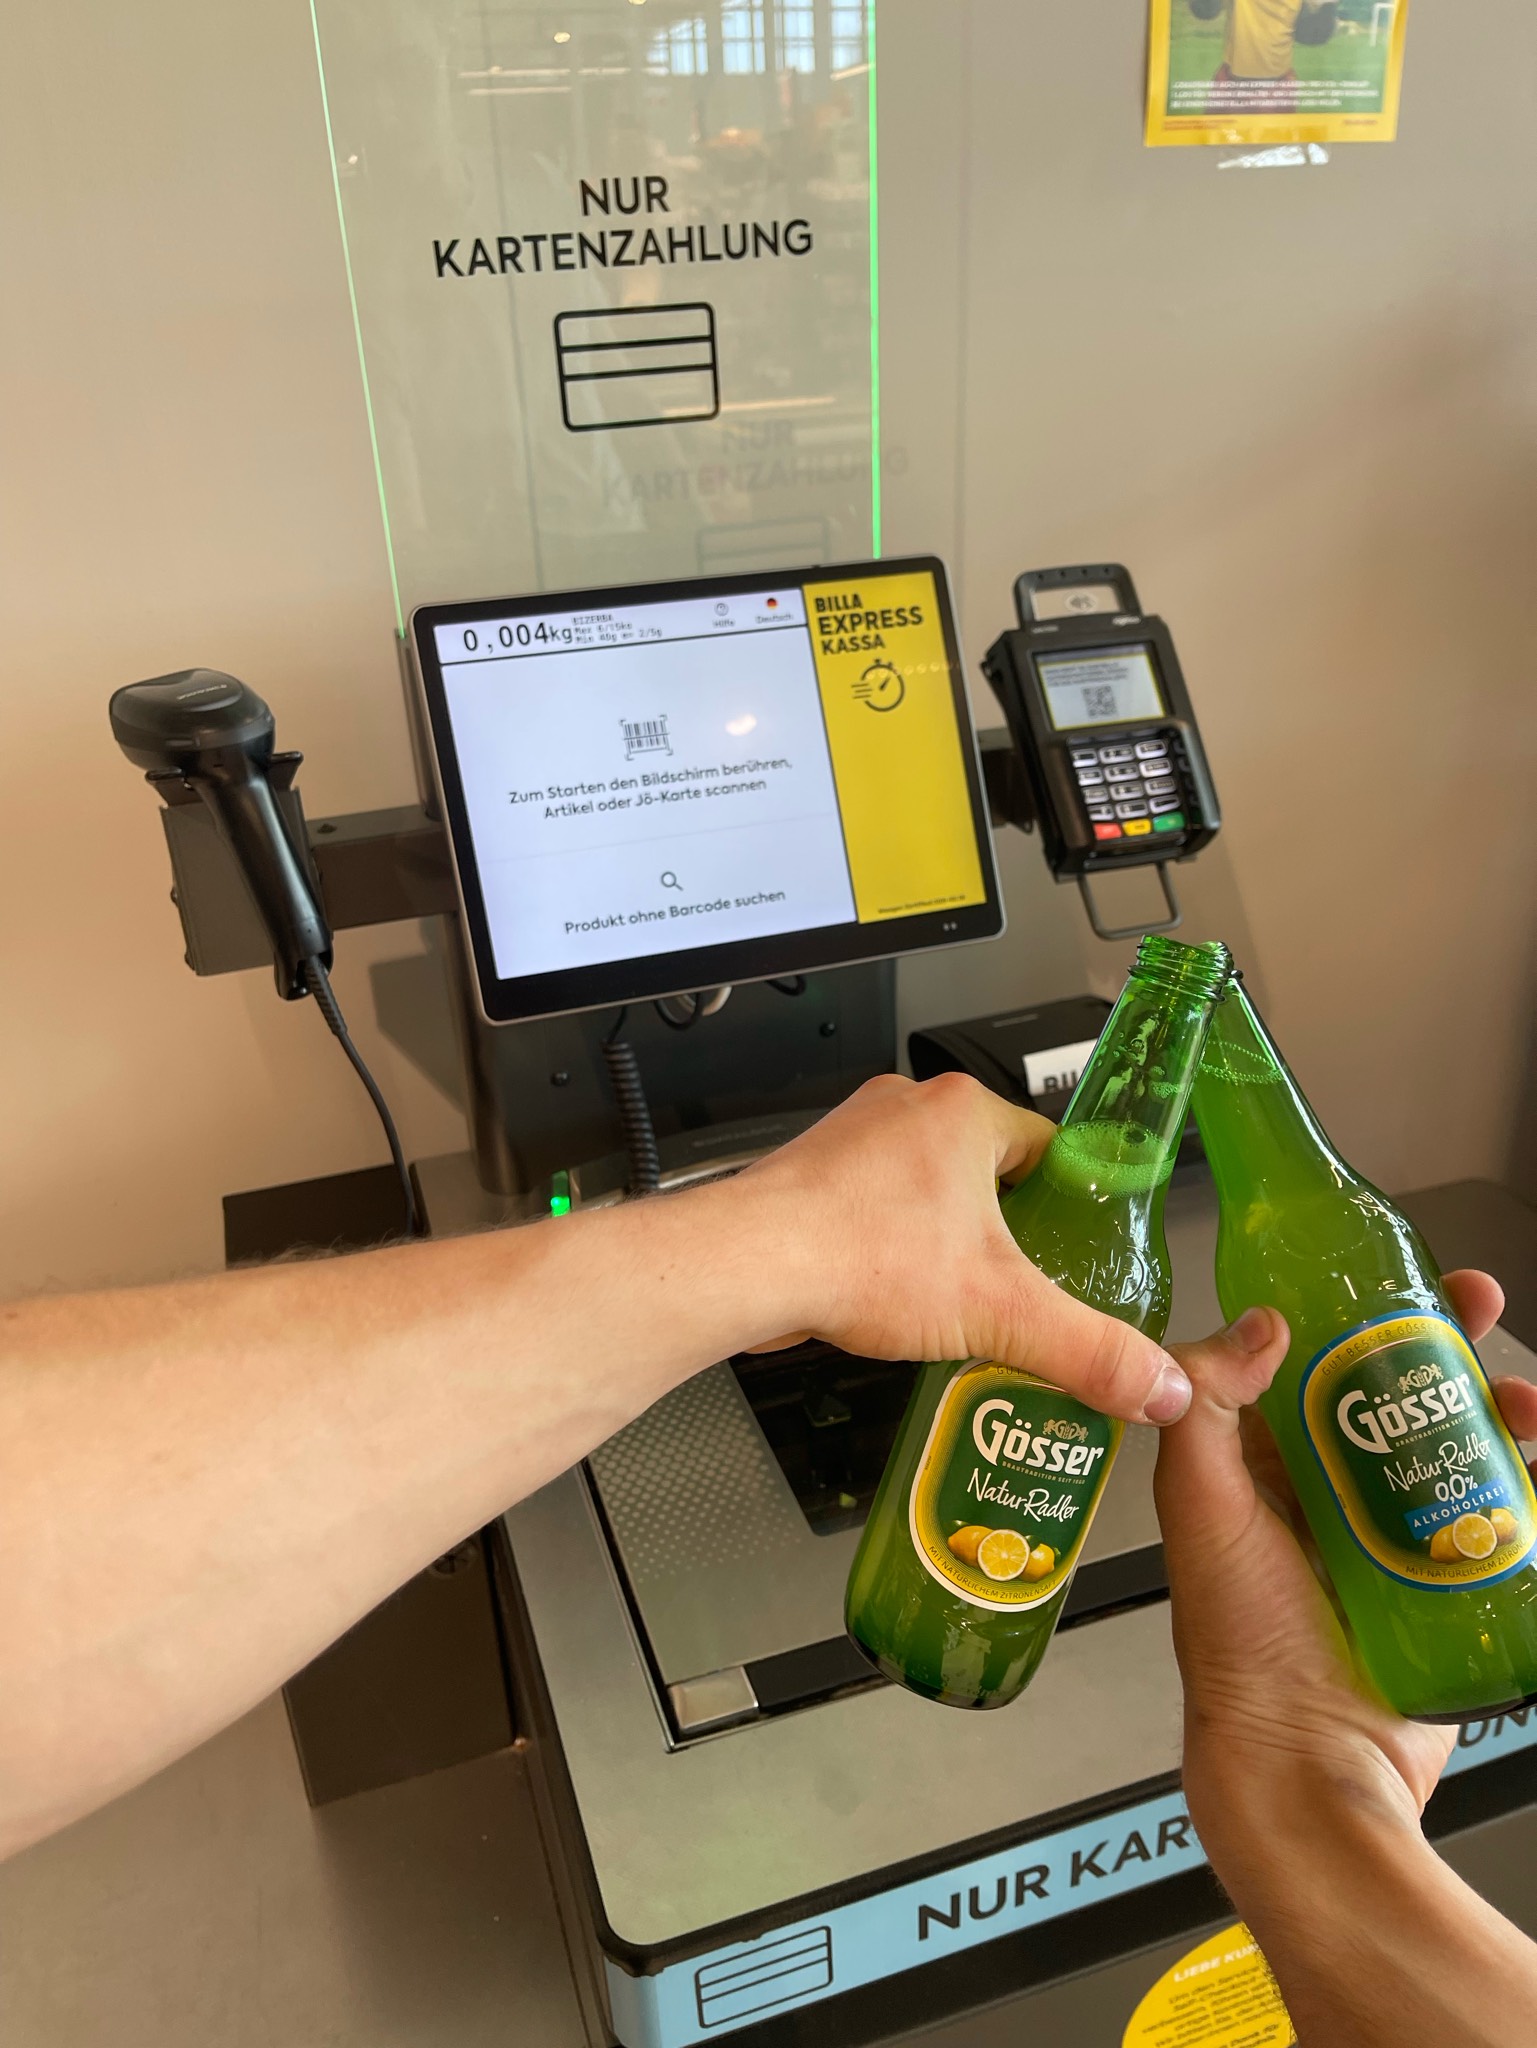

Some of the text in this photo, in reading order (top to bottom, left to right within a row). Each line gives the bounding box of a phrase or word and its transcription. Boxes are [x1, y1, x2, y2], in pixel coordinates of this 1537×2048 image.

[579, 176, 670, 216] NUR
[433, 219, 813, 277] KARTENZAHLUNG
[815, 594, 863, 612] BILLA
[818, 606, 923, 635] EXPRESS
[821, 634, 886, 655] KASSA
[509, 757, 793, 804] Zum Starten den Bildschirm berühren,
[544, 780, 767, 820] Artikel oder Jö-Karte scannen
[565, 889, 786, 935] Produkt ohne Barcode suchen
[1321, 1354, 1344, 1377] GUT
[1345, 1328, 1395, 1358] BESSER
[1337, 1373, 1471, 1454] Gösser
[972, 1398, 1104, 1476] Gösser
[1002, 1461, 1057, 1481] BRAUTRADITION
[1058, 1476, 1072, 1484] SEIT
[1434, 1474, 1478, 1504] 0,0%
[1414, 1485, 1505, 1528] ALKOHOLFREI
[928, 1546, 943, 1562] MIT
[1000, 1579, 1057, 1599] ZITRONENSAFT
[1405, 1565, 1425, 1576] MIT
[918, 1706, 1531, 1942] NUR KAR UN
[1173, 1943, 1259, 1983] LIEBE KUN
